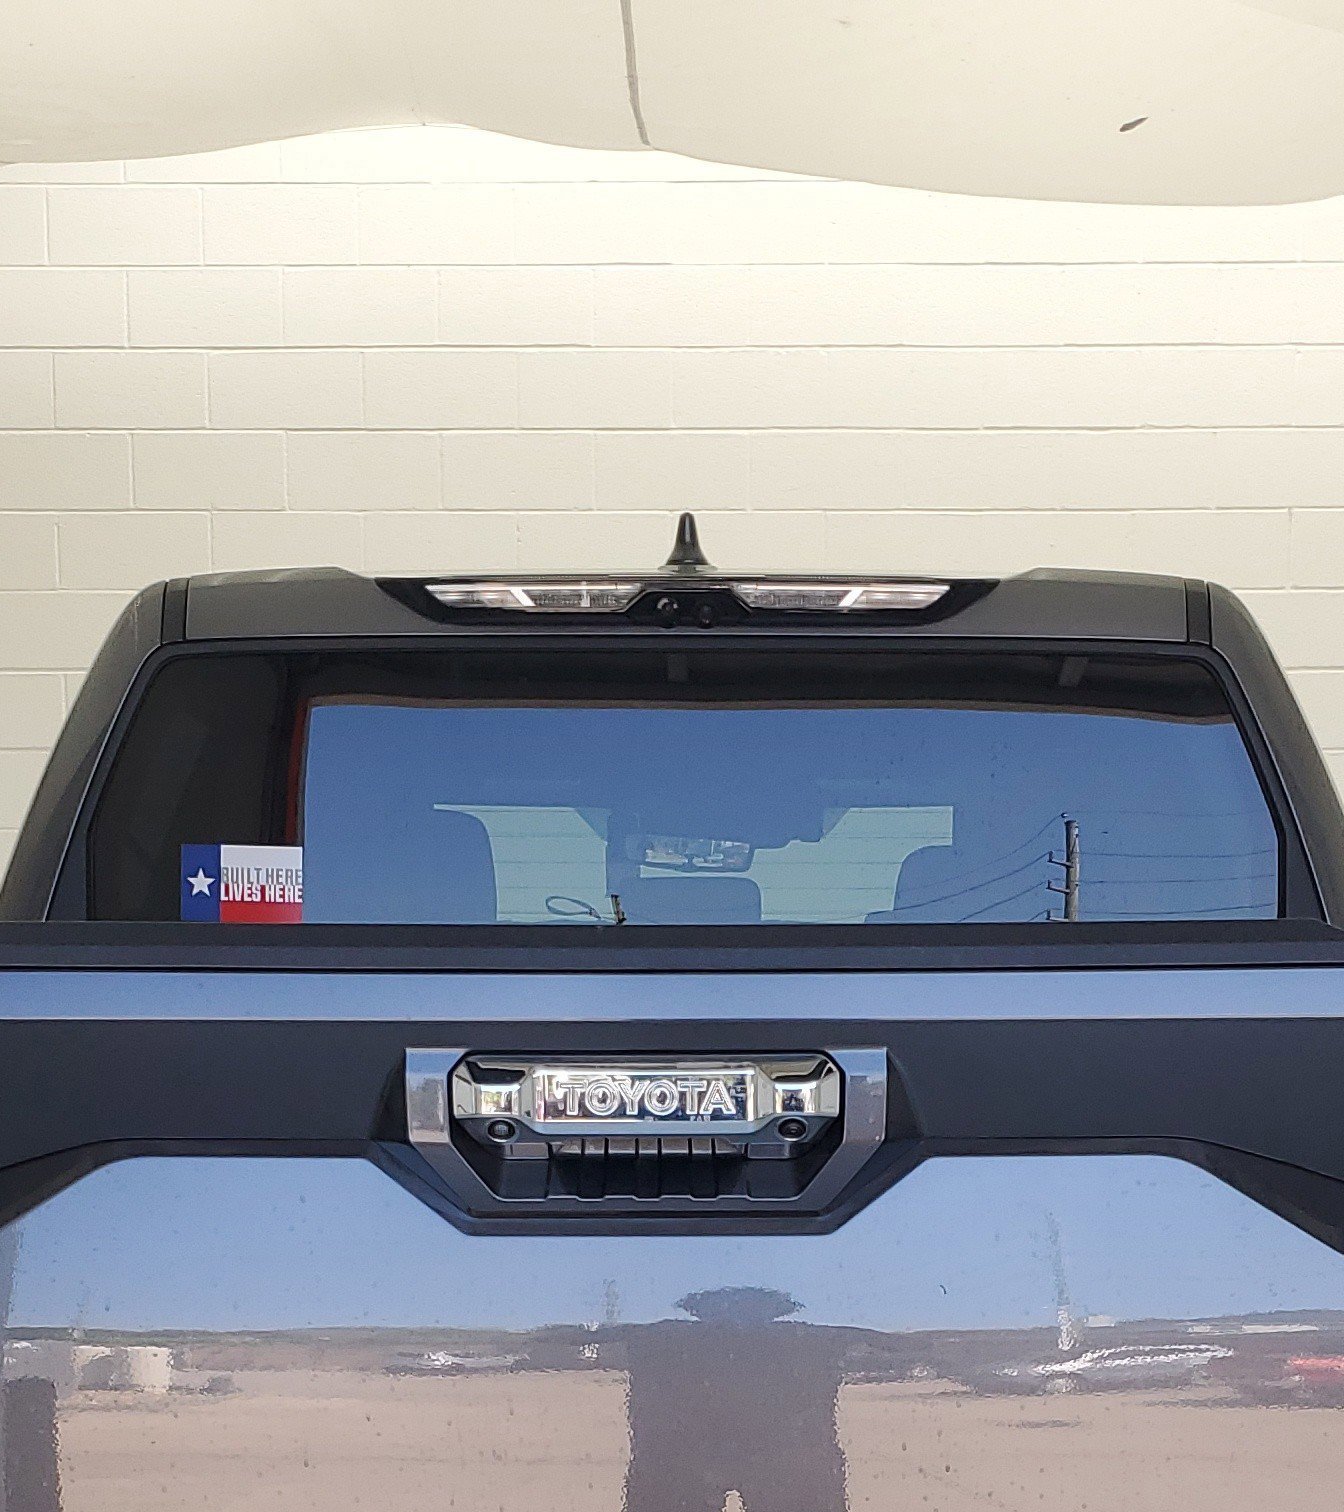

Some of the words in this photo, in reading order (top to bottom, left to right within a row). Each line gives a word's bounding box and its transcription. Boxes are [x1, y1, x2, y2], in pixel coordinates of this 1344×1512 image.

[222, 867, 262, 884] BUILT
[265, 868, 302, 885] HERE
[220, 883, 260, 901] LIVES
[265, 884, 303, 903] HERE
[560, 1078, 737, 1116] TOYOTA
